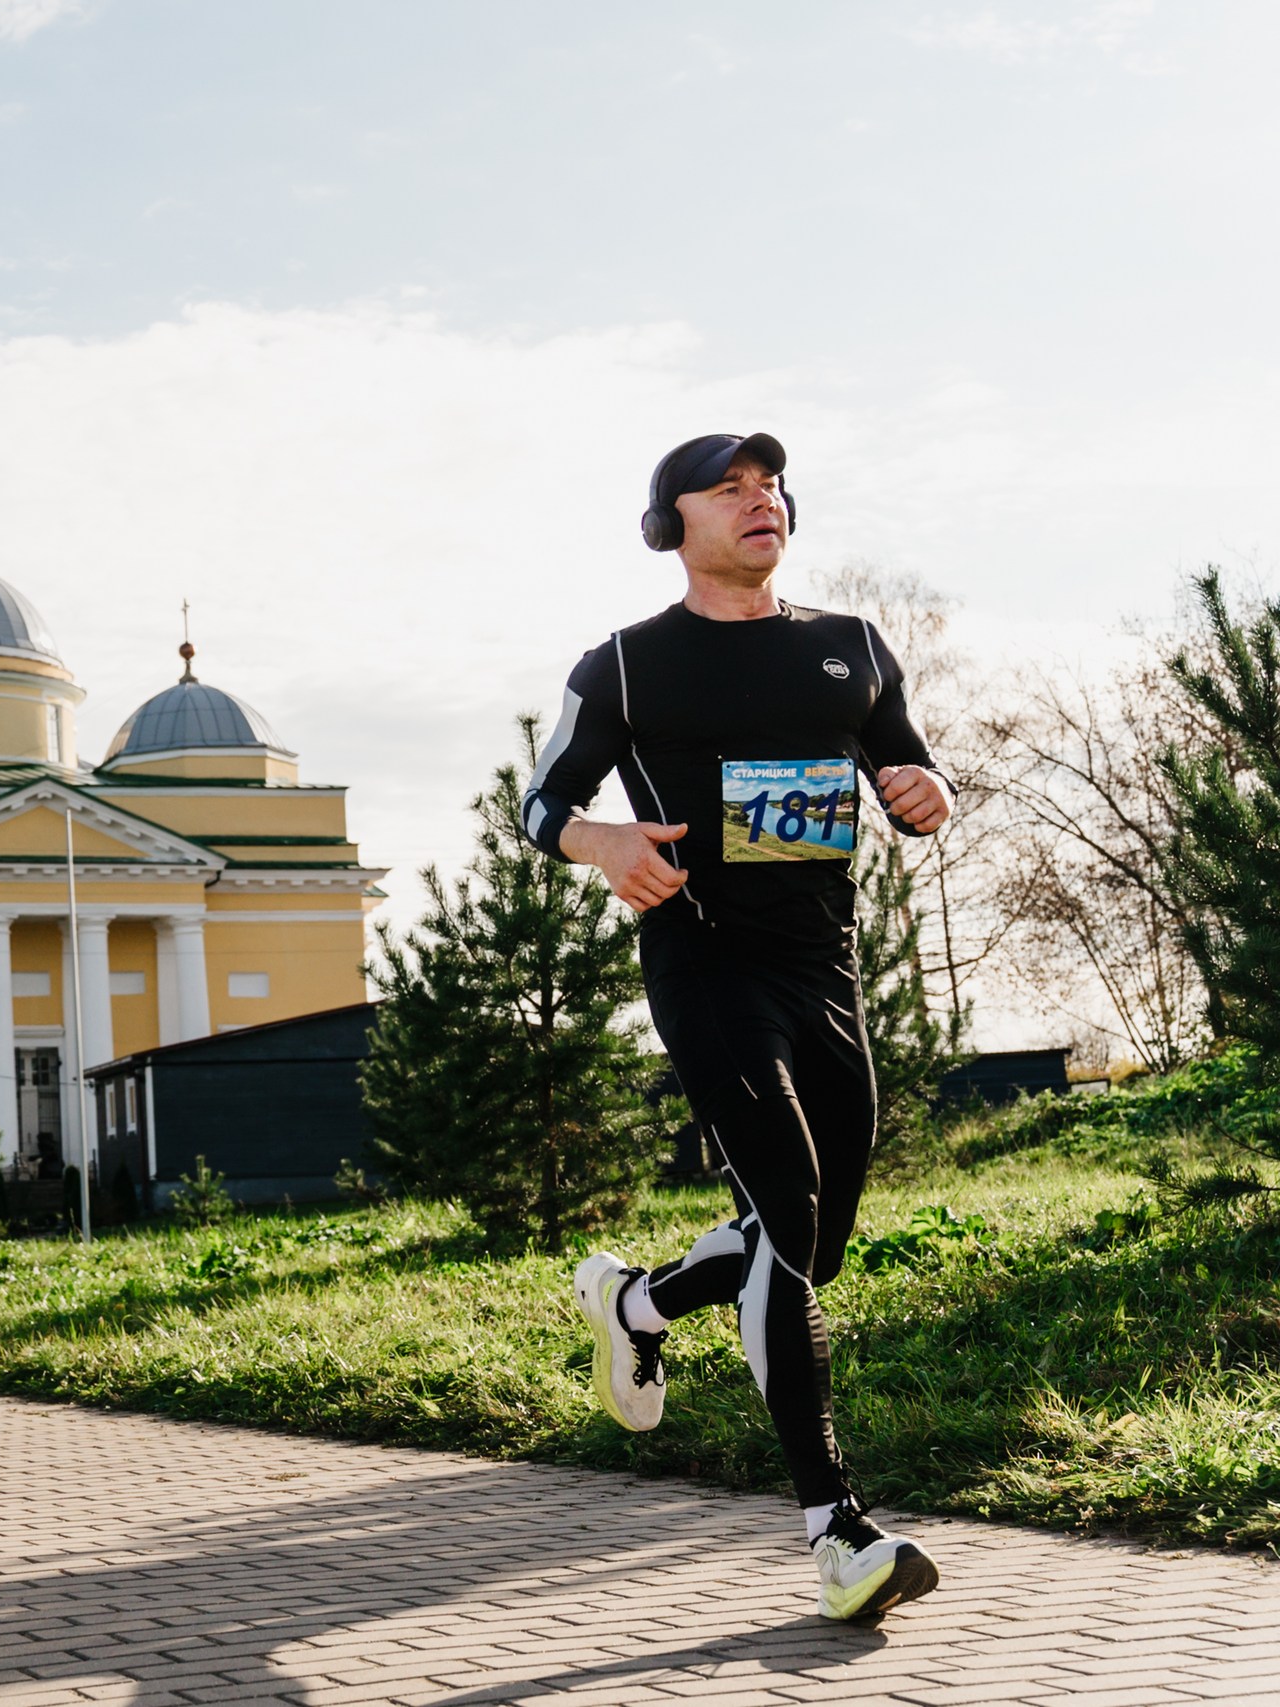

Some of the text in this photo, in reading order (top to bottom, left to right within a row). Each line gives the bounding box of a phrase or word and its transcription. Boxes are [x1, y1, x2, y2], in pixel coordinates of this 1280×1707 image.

[731, 765, 848, 780] СТАРИЦКИЕ ВЕРСТЫ
[741, 788, 841, 844] 181
